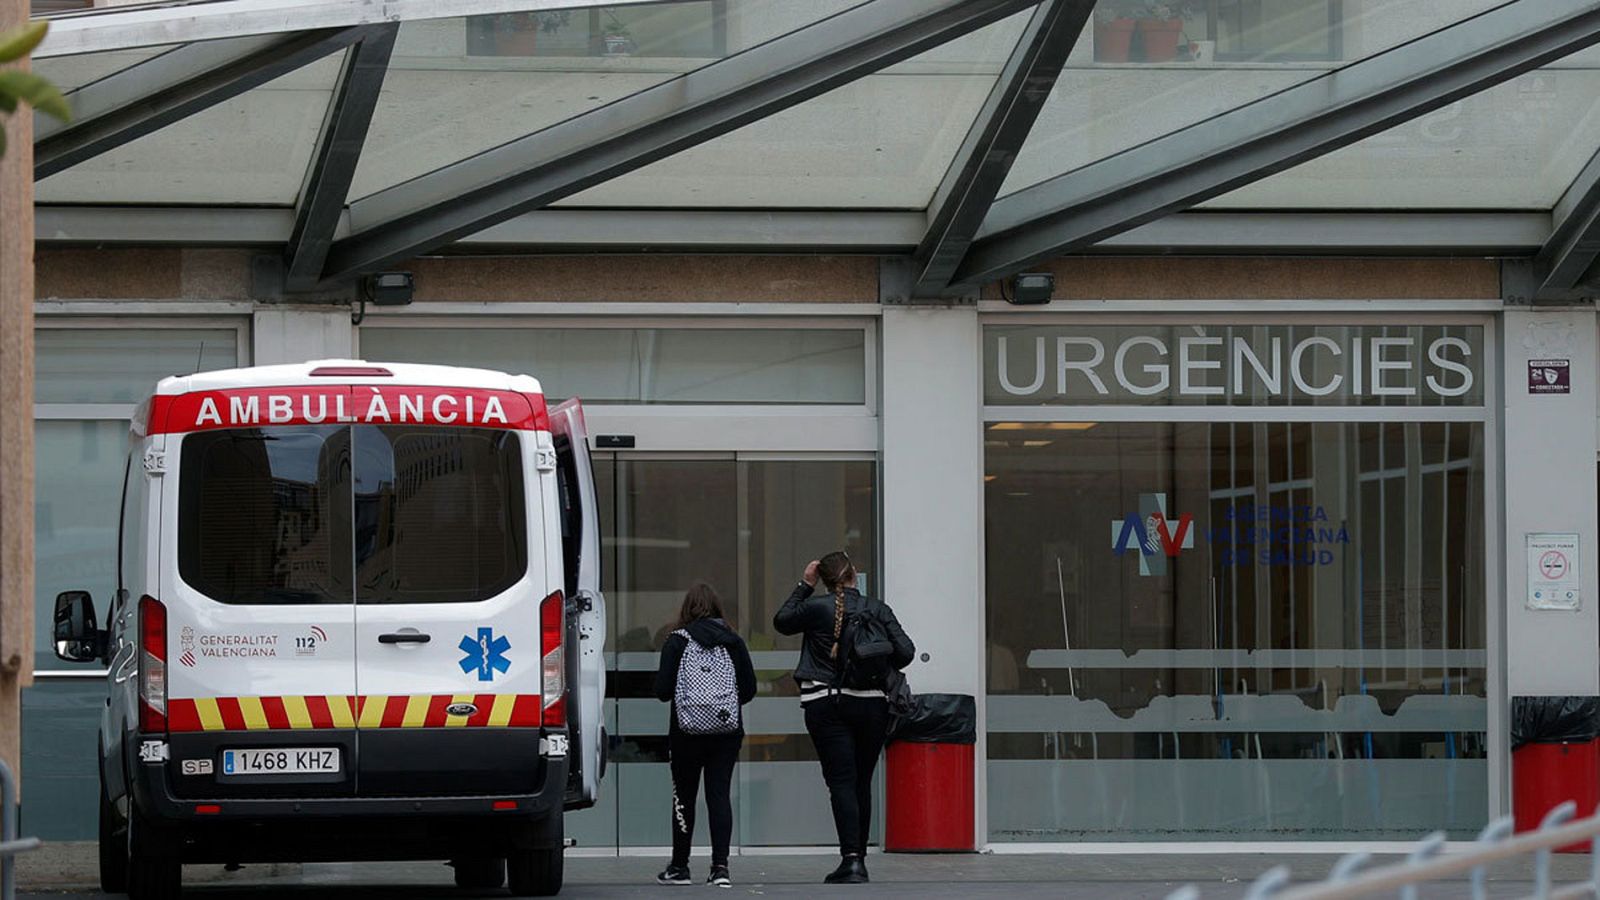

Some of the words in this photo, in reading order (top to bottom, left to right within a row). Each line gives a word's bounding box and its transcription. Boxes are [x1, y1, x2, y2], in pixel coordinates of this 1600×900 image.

[998, 325, 1474, 396] URGÈNCIES
[195, 387, 508, 425] AMBULÀNCIA
[1203, 527, 1350, 544] VALENCIANA
[1259, 548, 1334, 566] SALUD
[200, 635, 278, 645] GENERALITAT
[295, 637, 316, 648] 112
[201, 647, 277, 657] VALENCIANA
[184, 761, 211, 774] SP
[241, 752, 288, 770] 1468
[296, 751, 333, 769] KHZ
